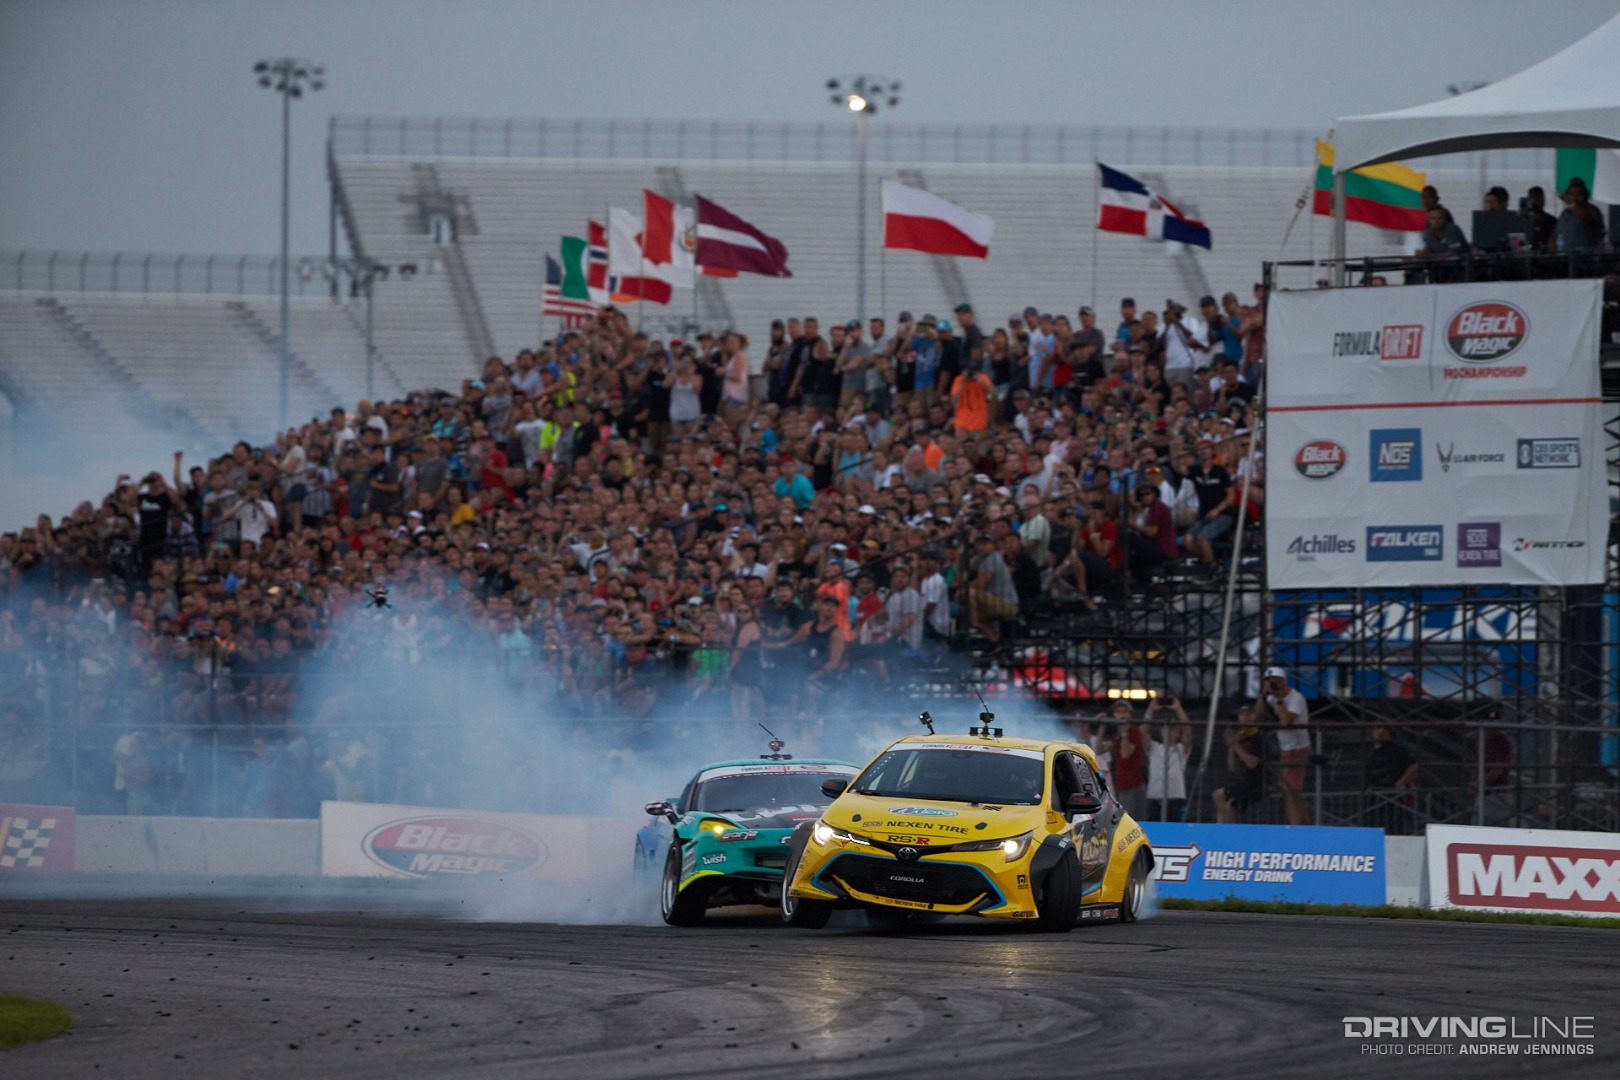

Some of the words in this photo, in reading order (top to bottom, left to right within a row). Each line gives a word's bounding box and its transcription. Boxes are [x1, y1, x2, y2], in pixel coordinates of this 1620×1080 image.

[1456, 311, 1520, 335] Black
[1333, 331, 1382, 357] FORMULA
[1382, 326, 1422, 359] DRIFT
[1460, 336, 1517, 356] Magic
[1301, 445, 1341, 462] Black
[1286, 534, 1356, 554] Achilles
[1371, 531, 1440, 547] FALKEN
[886, 820, 934, 830] NEXEN
[937, 823, 970, 835] TIRE
[394, 823, 520, 854] Black
[1204, 850, 1247, 869] HIGH
[1248, 852, 1377, 873] PERFORMANCE
[889, 875, 925, 884] COROLLA
[1202, 868, 1253, 882] ENERGY
[1253, 869, 1294, 883] DRINK
